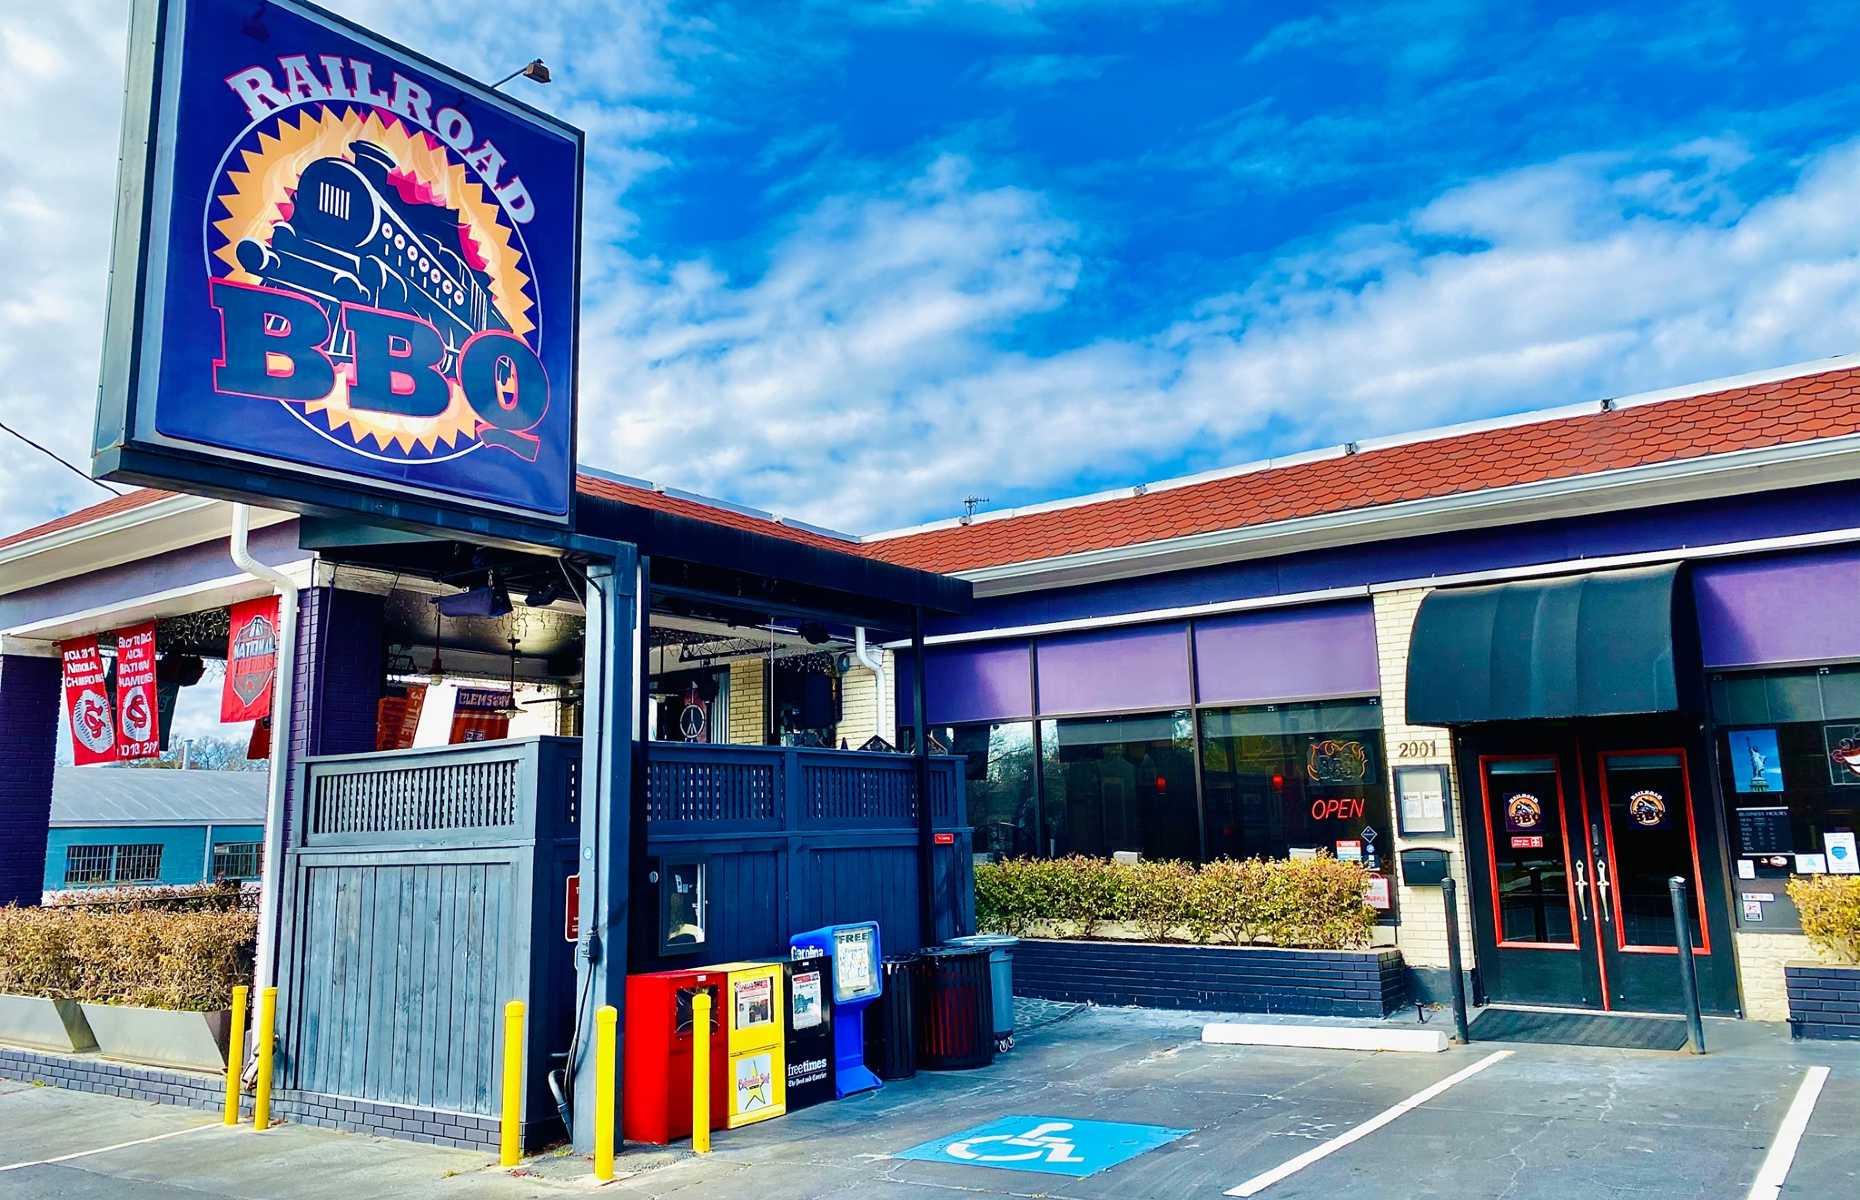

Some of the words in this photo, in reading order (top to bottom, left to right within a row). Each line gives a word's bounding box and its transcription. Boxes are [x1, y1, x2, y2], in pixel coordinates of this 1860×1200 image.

[224, 53, 536, 225] RAILROAD
[208, 276, 551, 462] BBQ
[459, 692, 511, 707] CLEMSON
[1399, 741, 1436, 758] 2001
[1311, 798, 1365, 820] OPEN
[839, 932, 870, 944] FREE
[791, 945, 824, 961] Carolina
